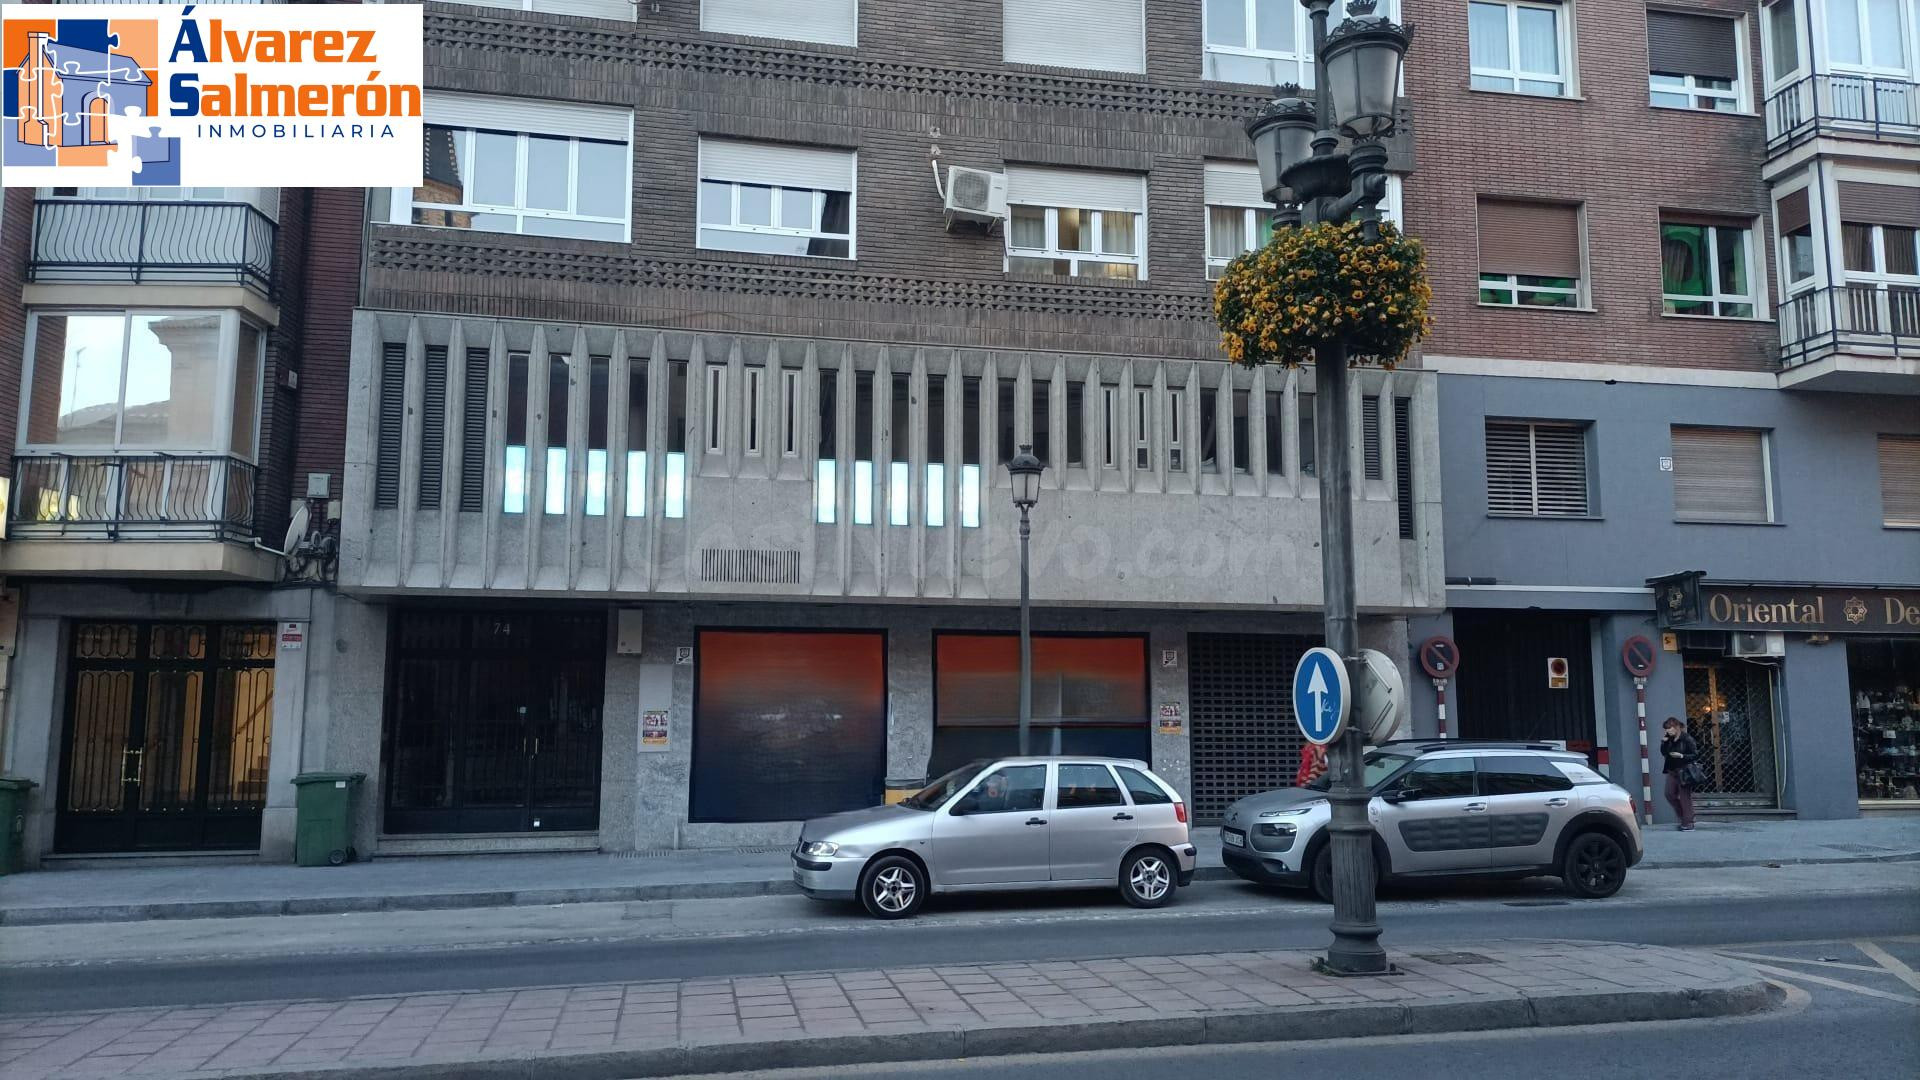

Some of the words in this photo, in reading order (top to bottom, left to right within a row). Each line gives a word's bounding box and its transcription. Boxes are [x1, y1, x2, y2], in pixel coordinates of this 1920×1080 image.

[1709, 593, 1825, 624] Oriental
[1882, 597, 1920, 625] De
[494, 622, 510, 635] 74
